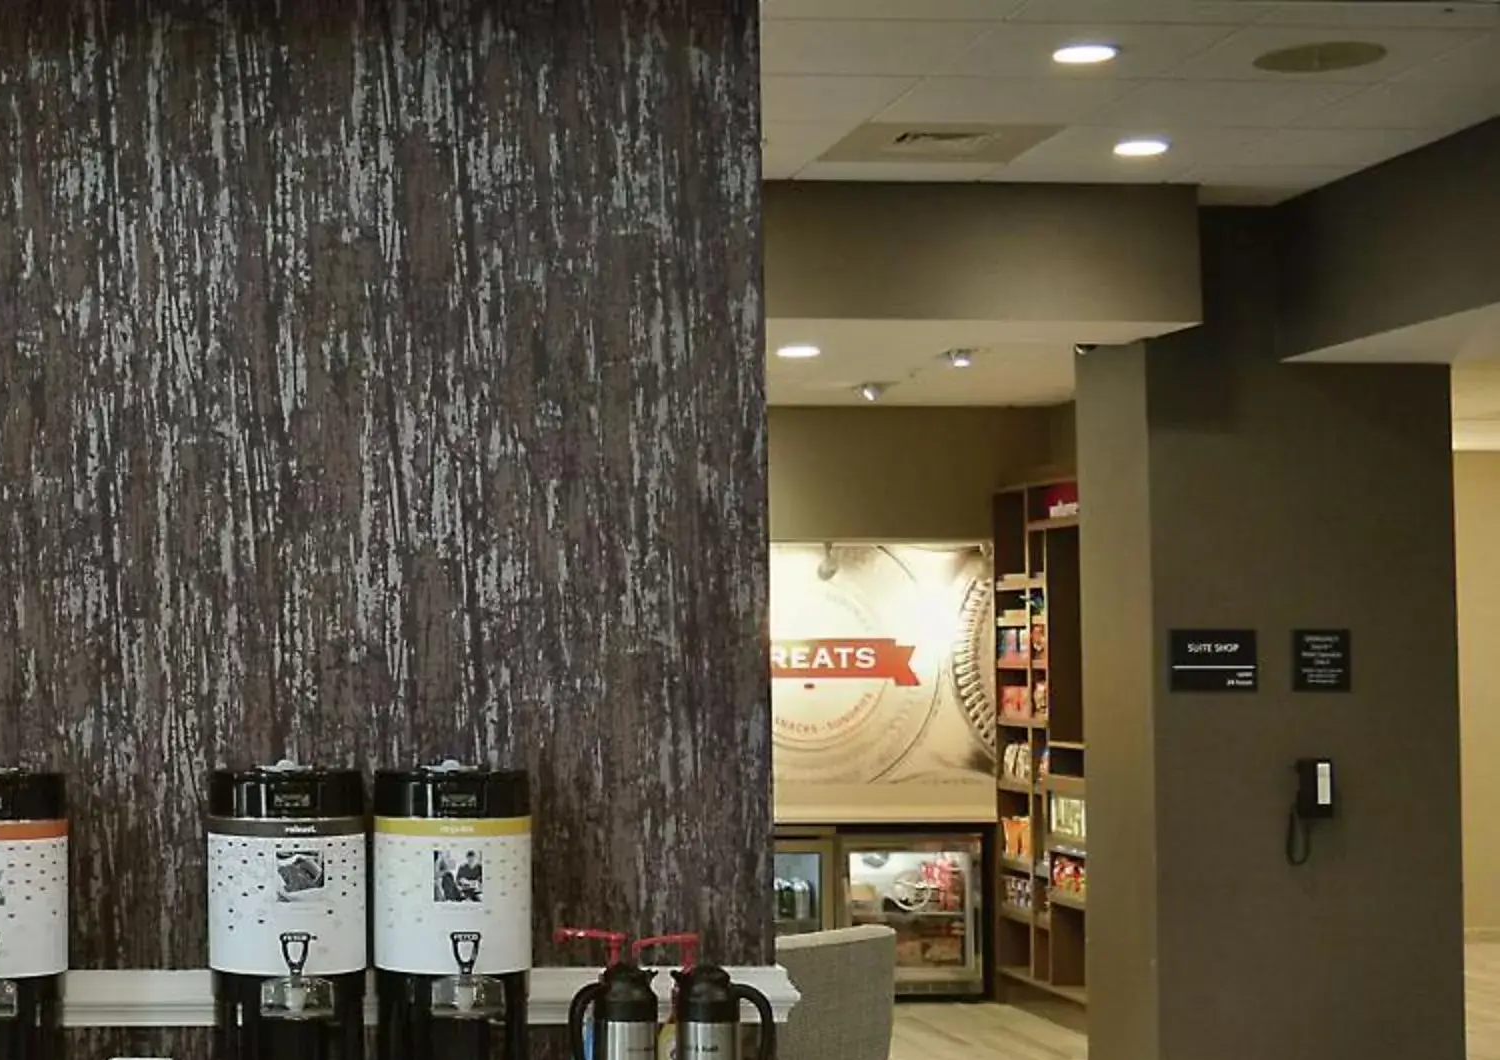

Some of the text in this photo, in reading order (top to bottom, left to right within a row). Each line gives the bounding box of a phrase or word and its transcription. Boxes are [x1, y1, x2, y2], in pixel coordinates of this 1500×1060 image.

[1187, 643, 1240, 653] SUITE SHOP
[770, 646, 876, 669] REATS
